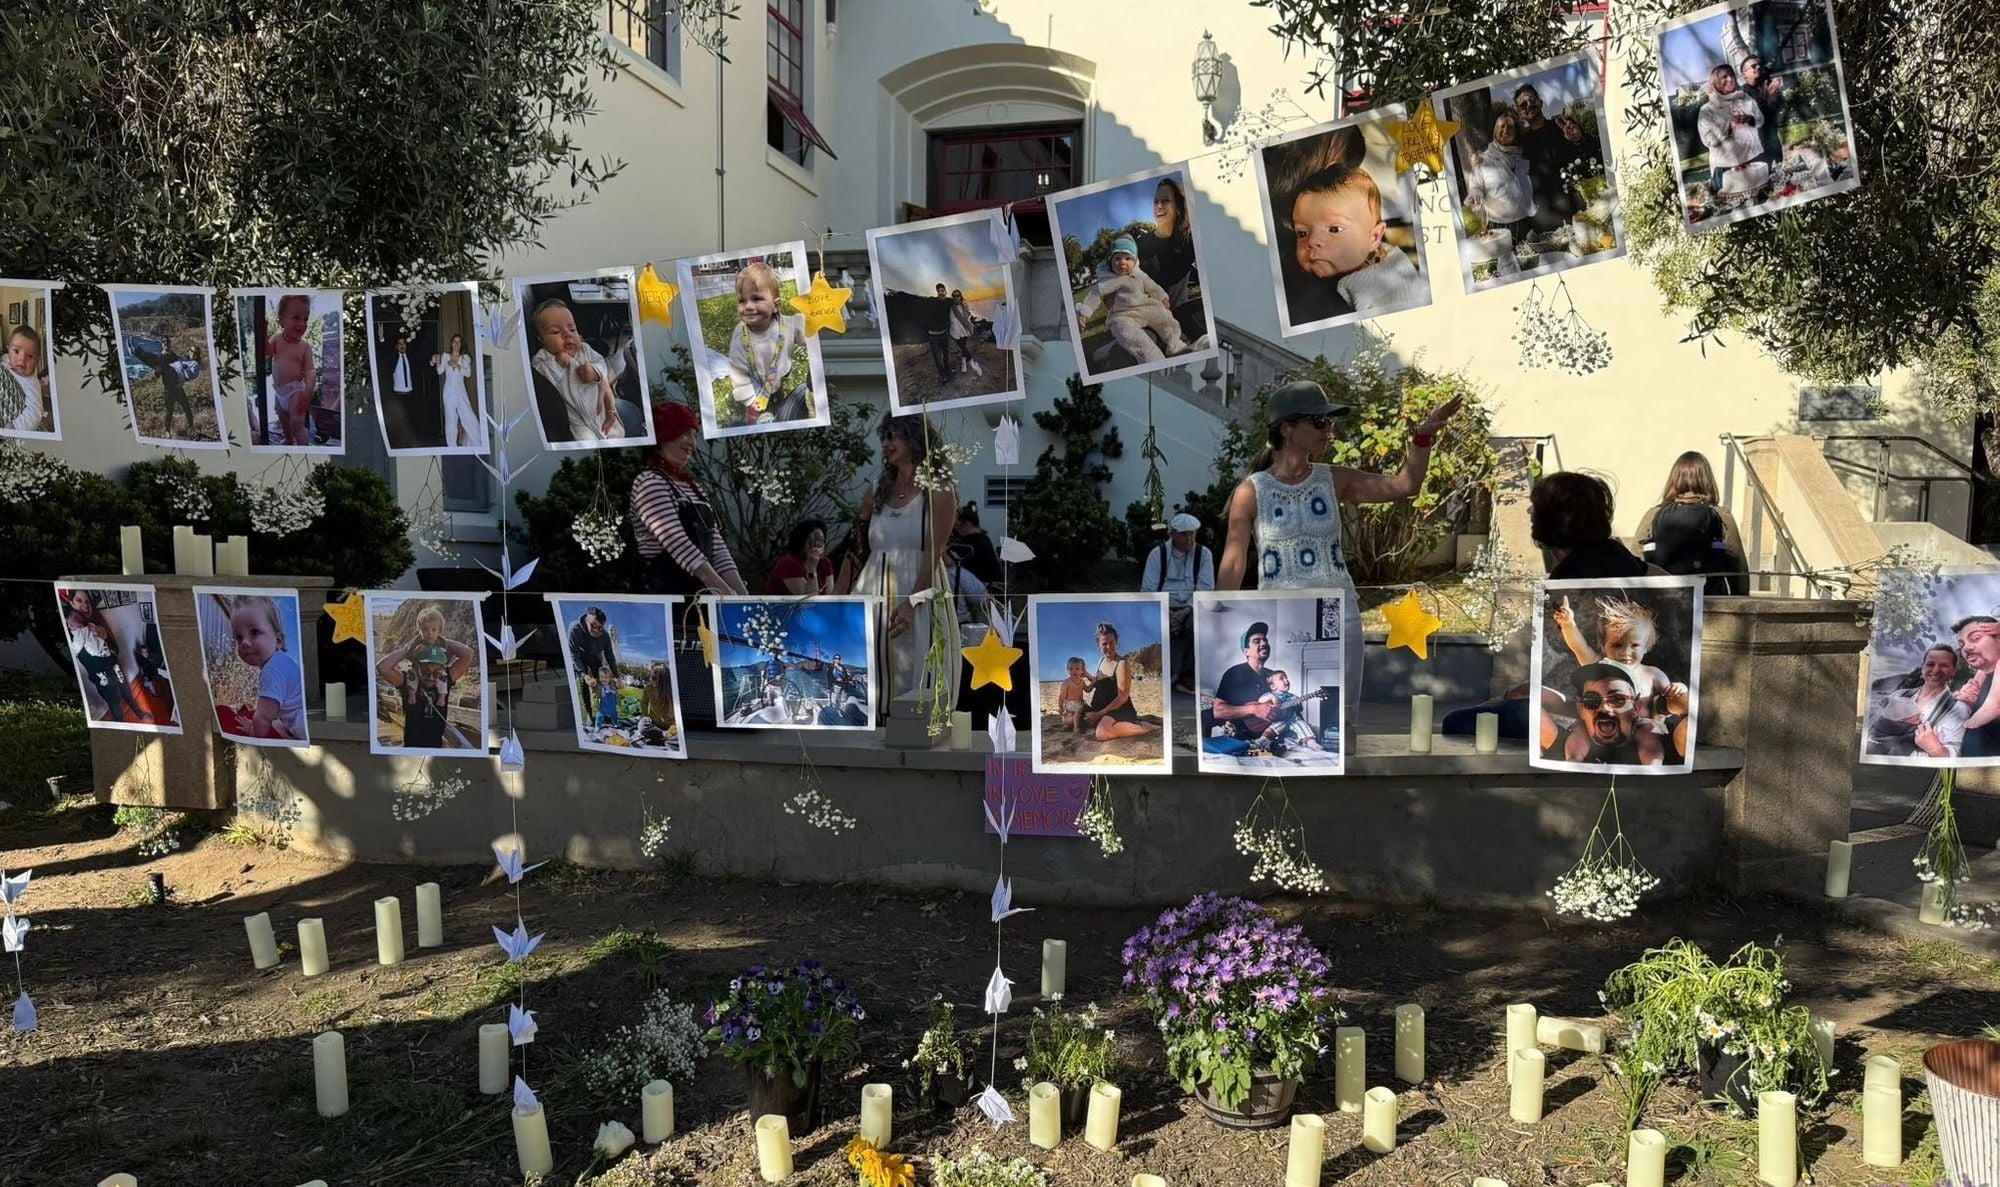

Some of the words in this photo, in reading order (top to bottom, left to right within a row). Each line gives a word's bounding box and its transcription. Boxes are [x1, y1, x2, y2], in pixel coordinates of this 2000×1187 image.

[1402, 120, 1431, 133] LOVE
[639, 290, 671, 305] IEGO
[807, 293, 833, 305] LOVE
[986, 785, 1002, 804] IN
[1012, 783, 1060, 807] LOVE
